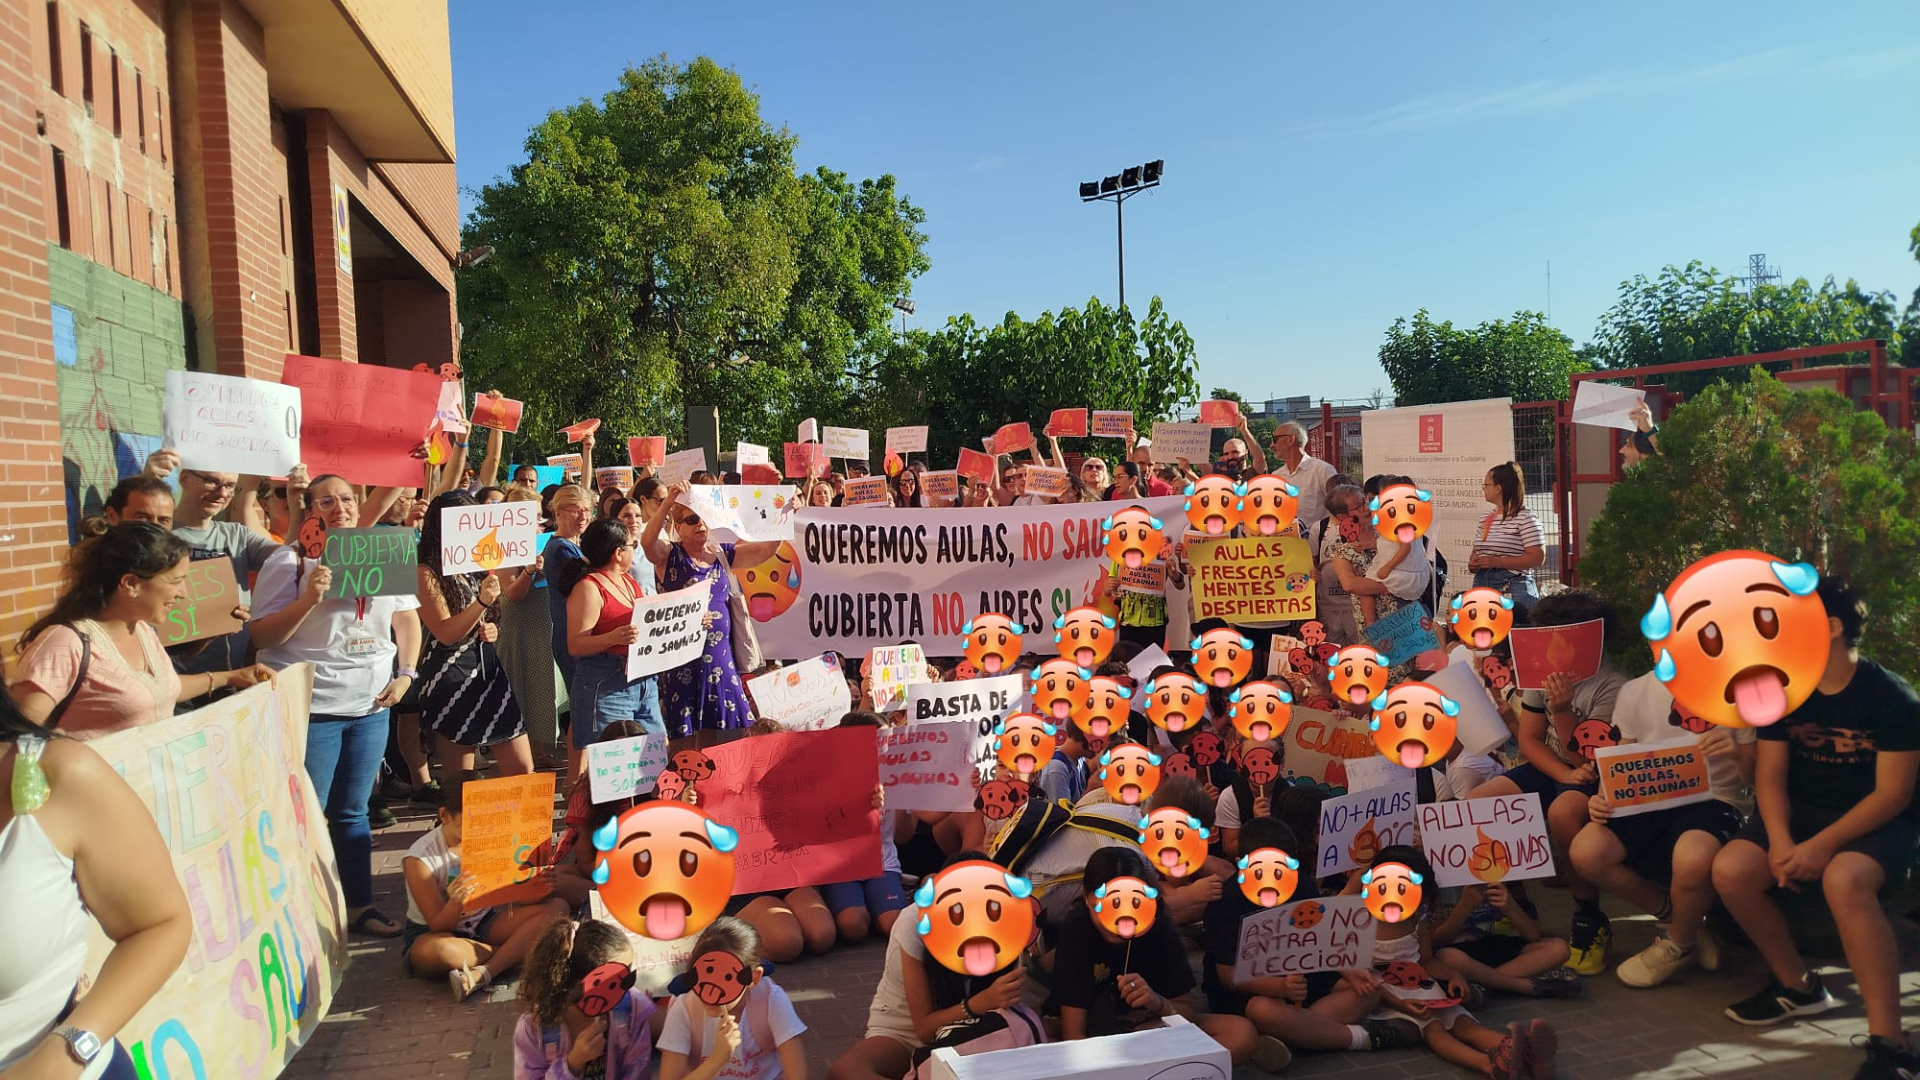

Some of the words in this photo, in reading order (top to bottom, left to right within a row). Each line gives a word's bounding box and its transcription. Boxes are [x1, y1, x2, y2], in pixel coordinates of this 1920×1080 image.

[325, 531, 418, 567] CUBIERTA
[443, 545, 467, 567] NO
[470, 540, 529, 563] SAUNAS
[804, 522, 928, 565] QUEREMOS
[936, 522, 1015, 568] AULAS,
[1022, 521, 1054, 561] NO
[1214, 543, 1283, 561] AULAS
[340, 566, 383, 598] NO
[1201, 564, 1286, 581] FRESCAS
[1203, 580, 1276, 597] MENTES
[644, 600, 701, 624] QUEREMOS
[808, 592, 924, 639] CUBIERTA
[932, 591, 965, 637] NO
[1201, 595, 1312, 617] DESPIERTAS
[637, 645, 653, 656] NO
[658, 630, 702, 654] SAUNAS
[874, 689, 888, 708] NO
[916, 694, 982, 720] BASTA
[989, 690, 1008, 711] DE
[1610, 753, 1695, 778] ¡QUEREMOS
[1626, 769, 1680, 785] AULAS,
[1613, 788, 1636, 800] NO
[1638, 776, 1701, 797] SAUNAS!
[1365, 791, 1412, 817] AULAS
[1422, 798, 1534, 832] AULAS,
[1323, 844, 1338, 868] A
[1430, 843, 1467, 868] NO
[1472, 834, 1550, 872] SAUNAS
[1244, 909, 1288, 943] ASÍ
[1331, 906, 1374, 930] NO
[1242, 931, 1318, 961] ENTRA
[1330, 931, 1359, 948] LA
